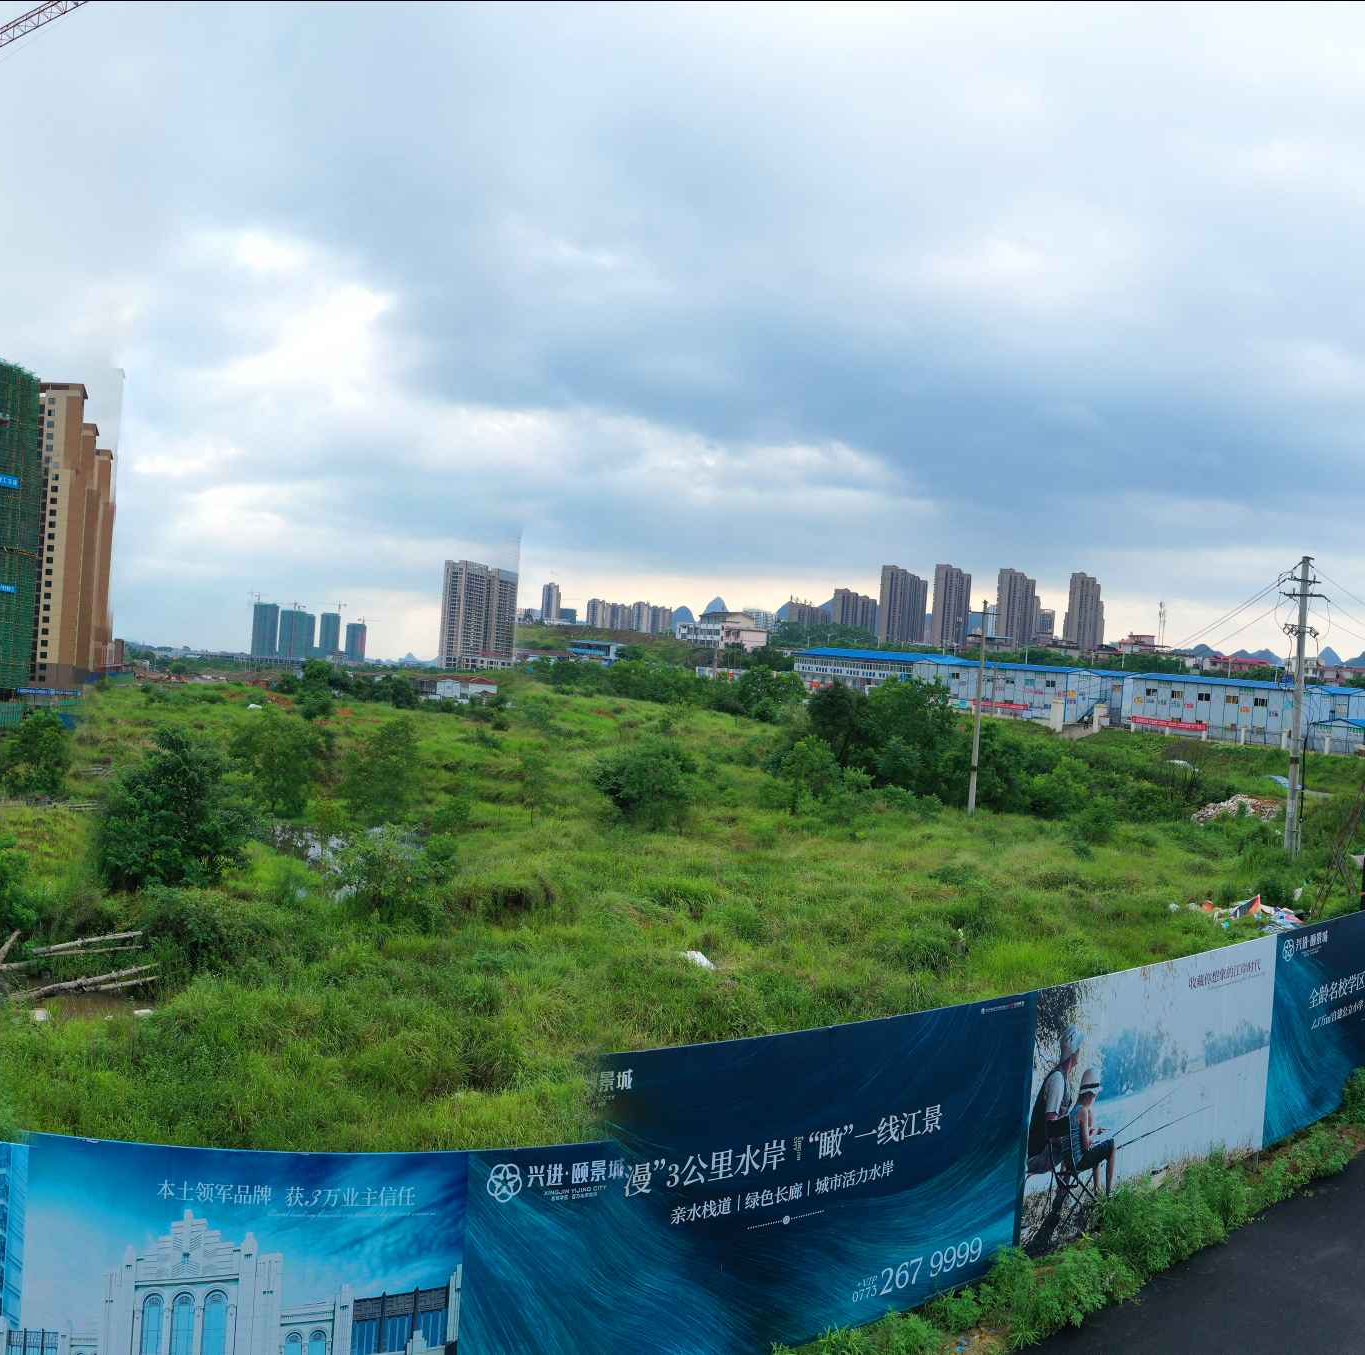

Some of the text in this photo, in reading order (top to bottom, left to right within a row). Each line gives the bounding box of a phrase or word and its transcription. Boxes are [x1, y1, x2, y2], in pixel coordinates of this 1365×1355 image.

[157, 1179, 416, 1208] 本土领军品牌 获3万业主信任
[670, 1160, 894, 1225] 亲水栈道 绿色长廊 城市活力水岸
[852, 1237, 982, 1303] 0773 267 9999
